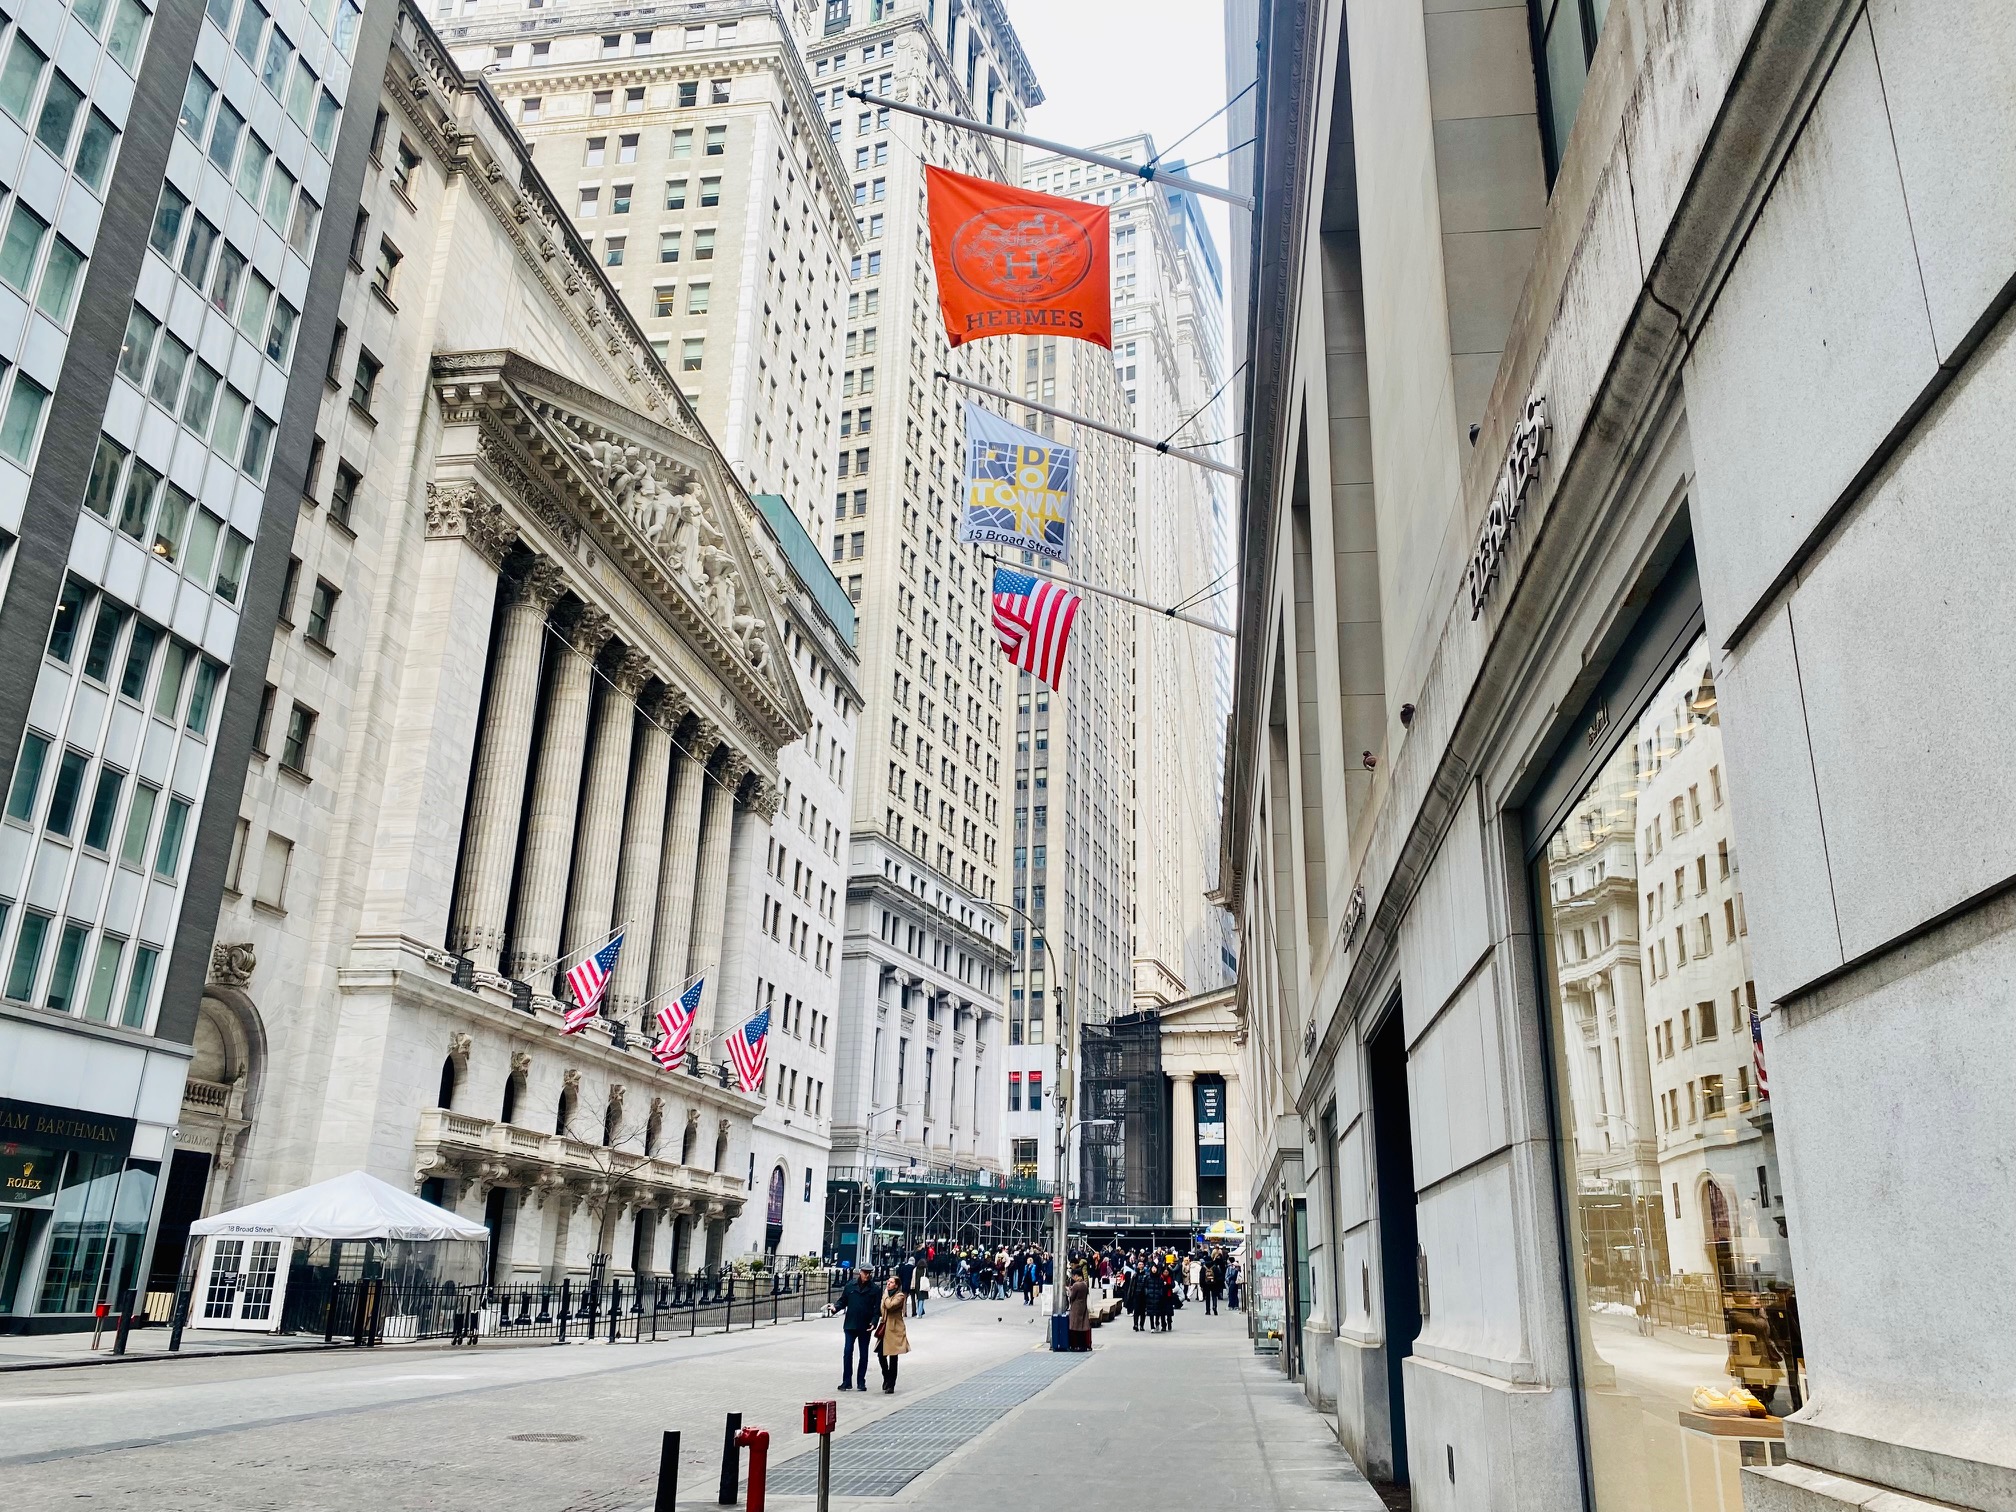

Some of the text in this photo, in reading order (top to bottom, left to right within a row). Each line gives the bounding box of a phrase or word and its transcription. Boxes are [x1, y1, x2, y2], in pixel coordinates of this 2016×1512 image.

[1002, 251, 1043, 281] H
[968, 529, 1062, 559] 15 Broad Street
[36, 1117, 118, 1142] BARTHMAN
[6, 1177, 43, 1190] ROLEX
